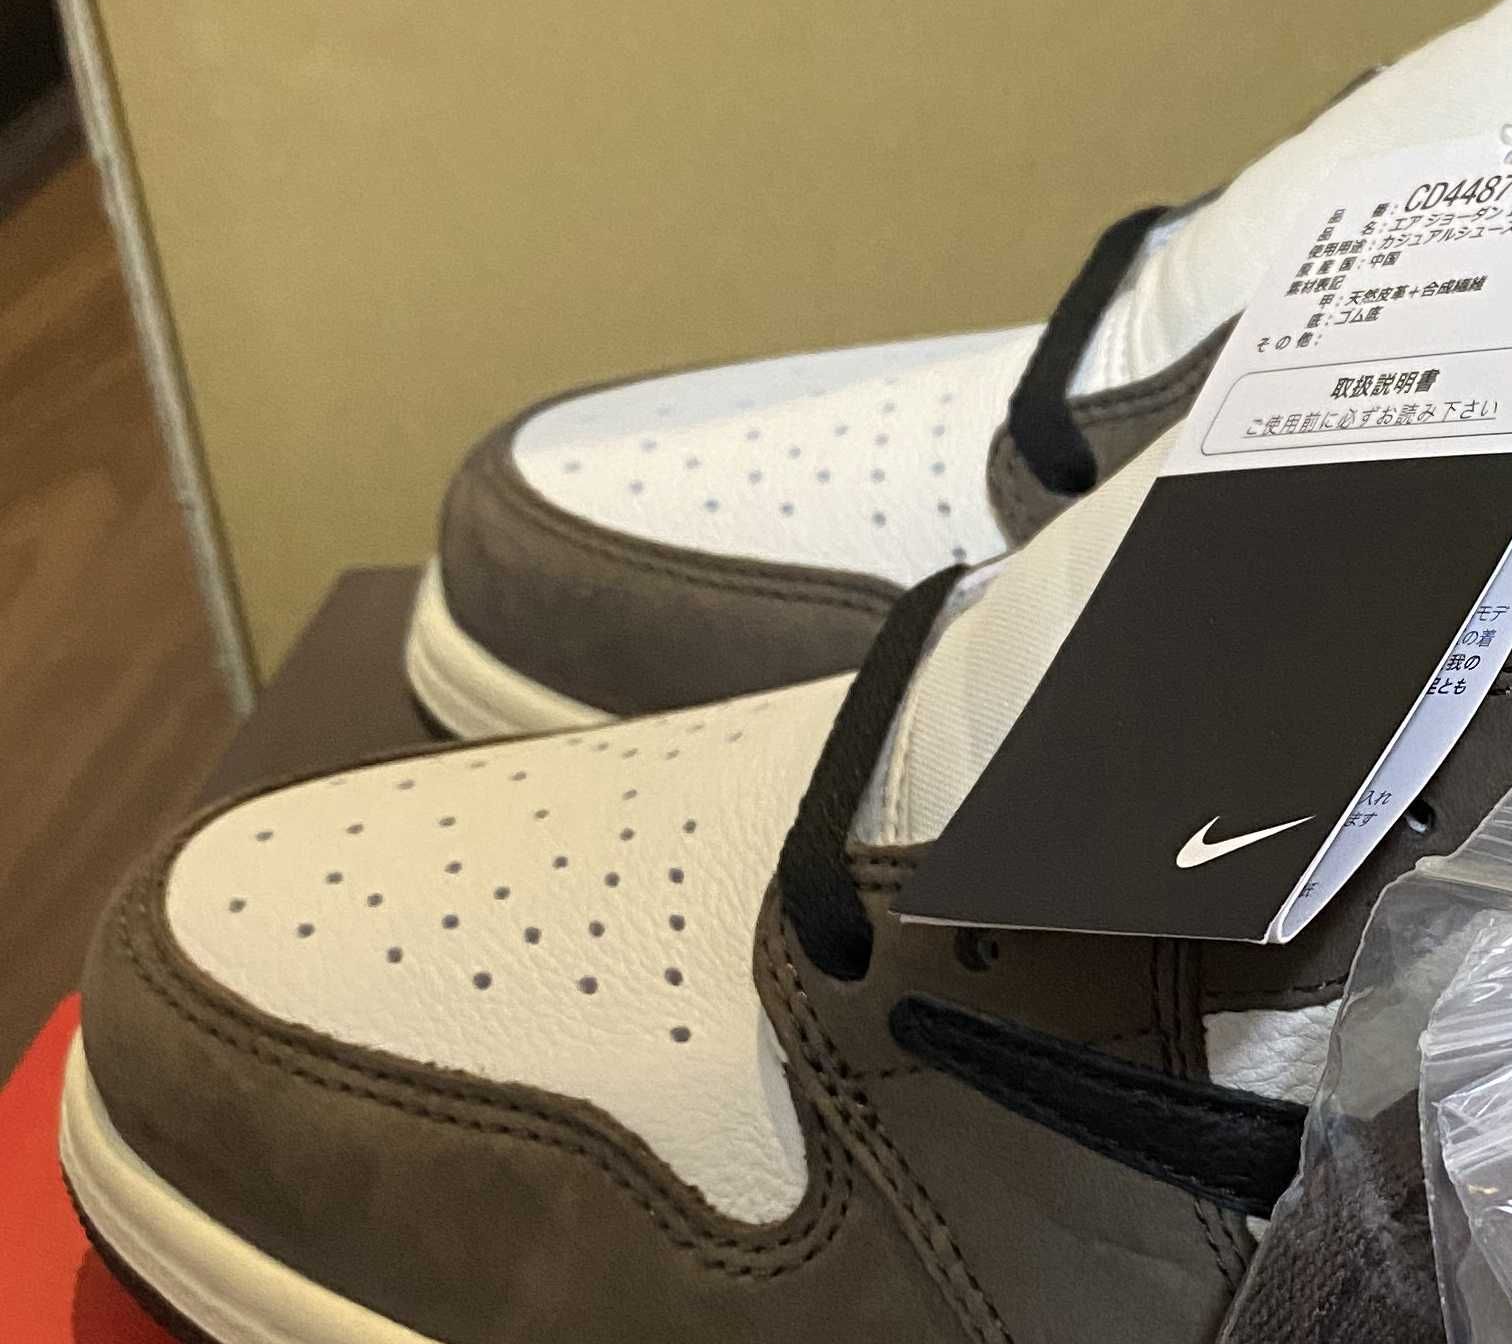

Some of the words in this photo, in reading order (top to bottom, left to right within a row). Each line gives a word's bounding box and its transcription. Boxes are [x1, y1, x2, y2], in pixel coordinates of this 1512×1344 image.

[1330, 368, 1440, 401] 取扱説明書
